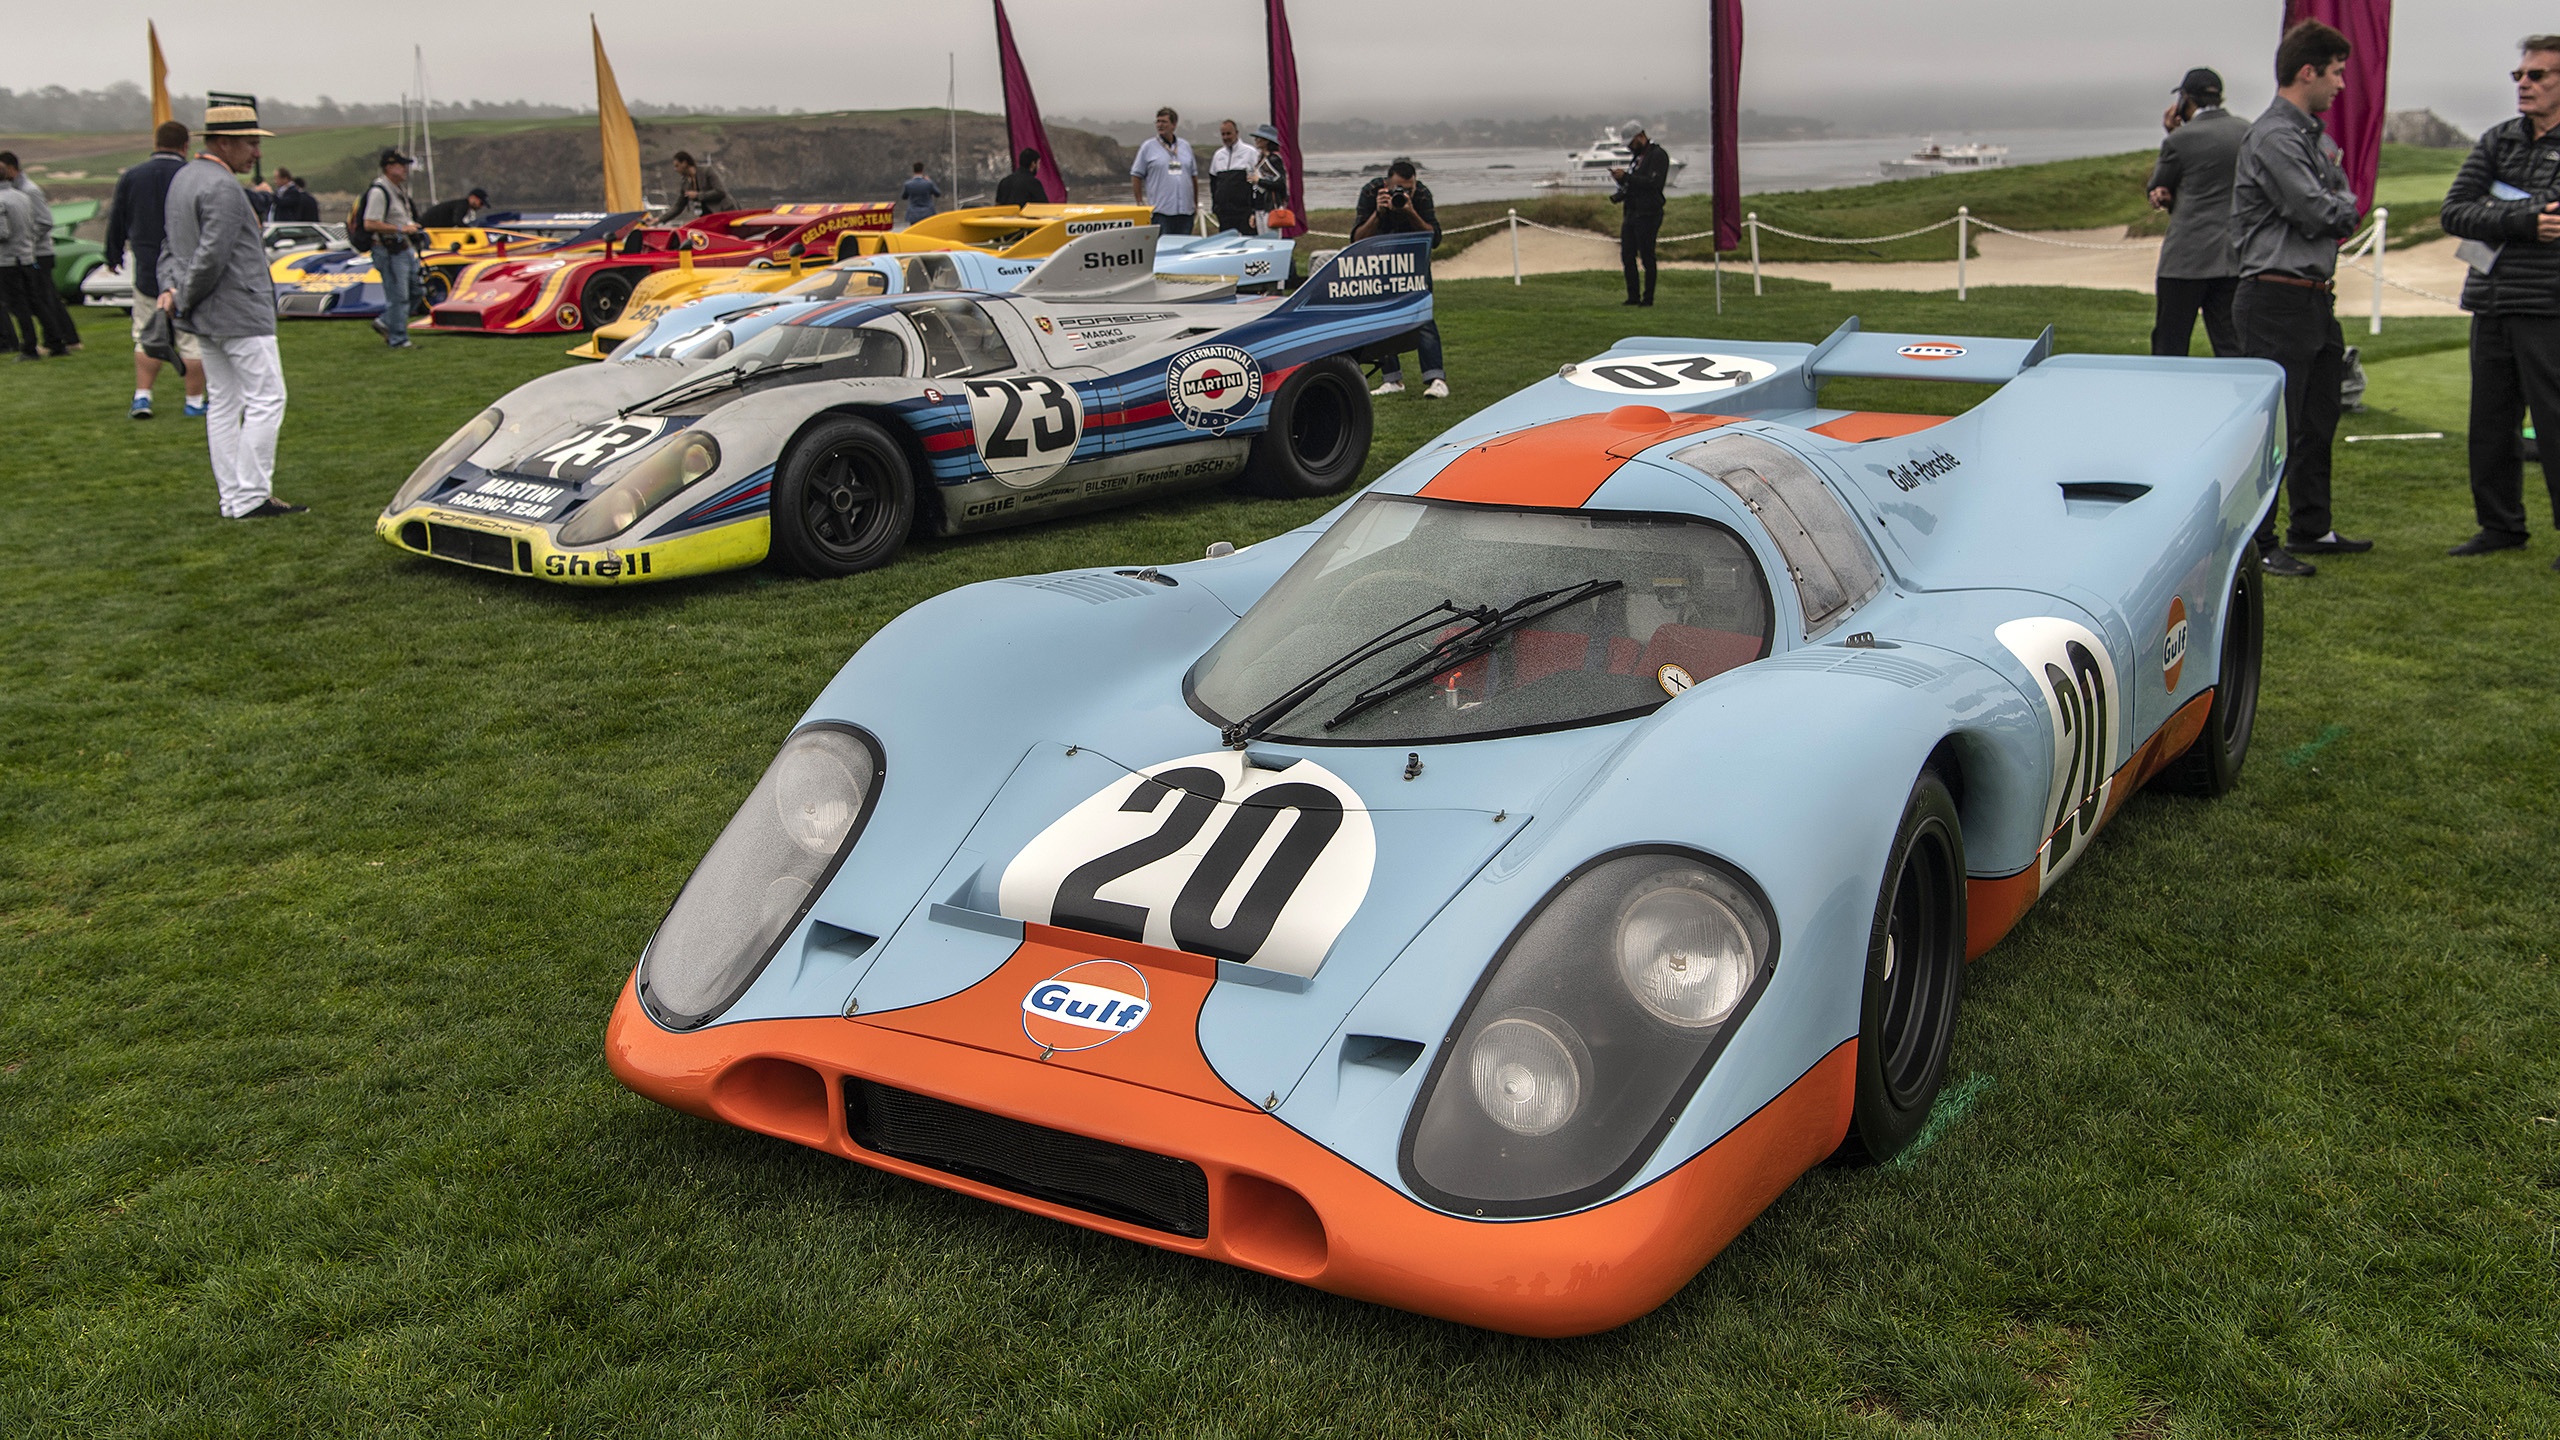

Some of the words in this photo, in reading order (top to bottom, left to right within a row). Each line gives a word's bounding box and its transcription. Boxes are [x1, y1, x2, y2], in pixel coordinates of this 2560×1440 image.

[801, 213, 892, 245] GELO-RACING-TEAM
[1084, 249, 1143, 269] Shell
[1337, 253, 1415, 278] MARTINI
[1328, 275, 1426, 298] RACING-TEAM
[1081, 328, 1123, 340] MARKO
[1176, 347, 1252, 370] INTERNATIONAL
[1185, 374, 1242, 395] MARTINI
[1247, 371, 1260, 400] CLUB
[1592, 357, 1746, 389] 20
[1169, 366, 1186, 415] MARTINI
[966, 376, 1076, 459] 23
[515, 423, 652, 483] 23
[1136, 468, 1179, 485] Firestone
[1184, 460, 1224, 477] BOSCH
[1887, 450, 1961, 492] Gulf-Porsche
[476, 478, 565, 504] MARTINI
[1085, 477, 1129, 492] BILSTEIN
[448, 492, 553, 519] RACING-TEAM
[545, 552, 652, 577] Shell
[2164, 626, 2187, 665] Gulf
[2045, 640, 2107, 875] 20
[1049, 766, 1344, 964] 20
[1030, 984, 1143, 1029] Gulf
